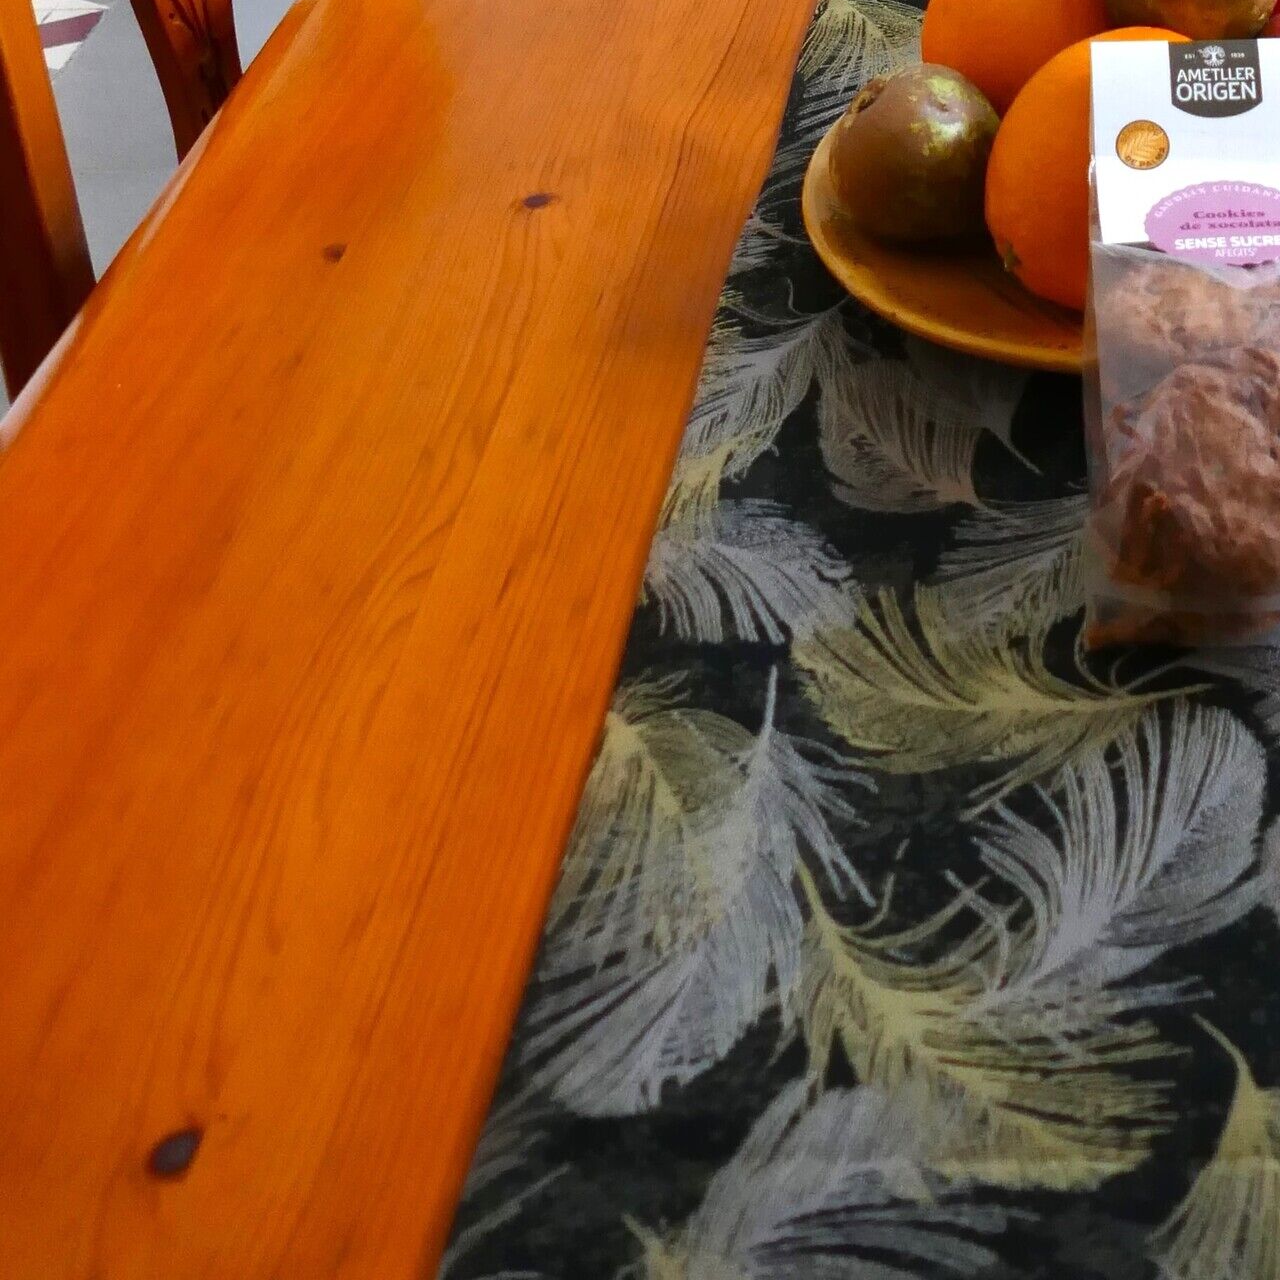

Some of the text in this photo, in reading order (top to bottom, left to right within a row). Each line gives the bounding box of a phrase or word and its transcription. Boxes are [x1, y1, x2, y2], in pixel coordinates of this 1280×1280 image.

[1177, 67, 1255, 82] AMETLLER
[1176, 81, 1257, 101] ORIGEN
[1192, 210, 1266, 219] Cookies
[1180, 222, 1201, 230] de
[1174, 236, 1227, 251] SENSE
